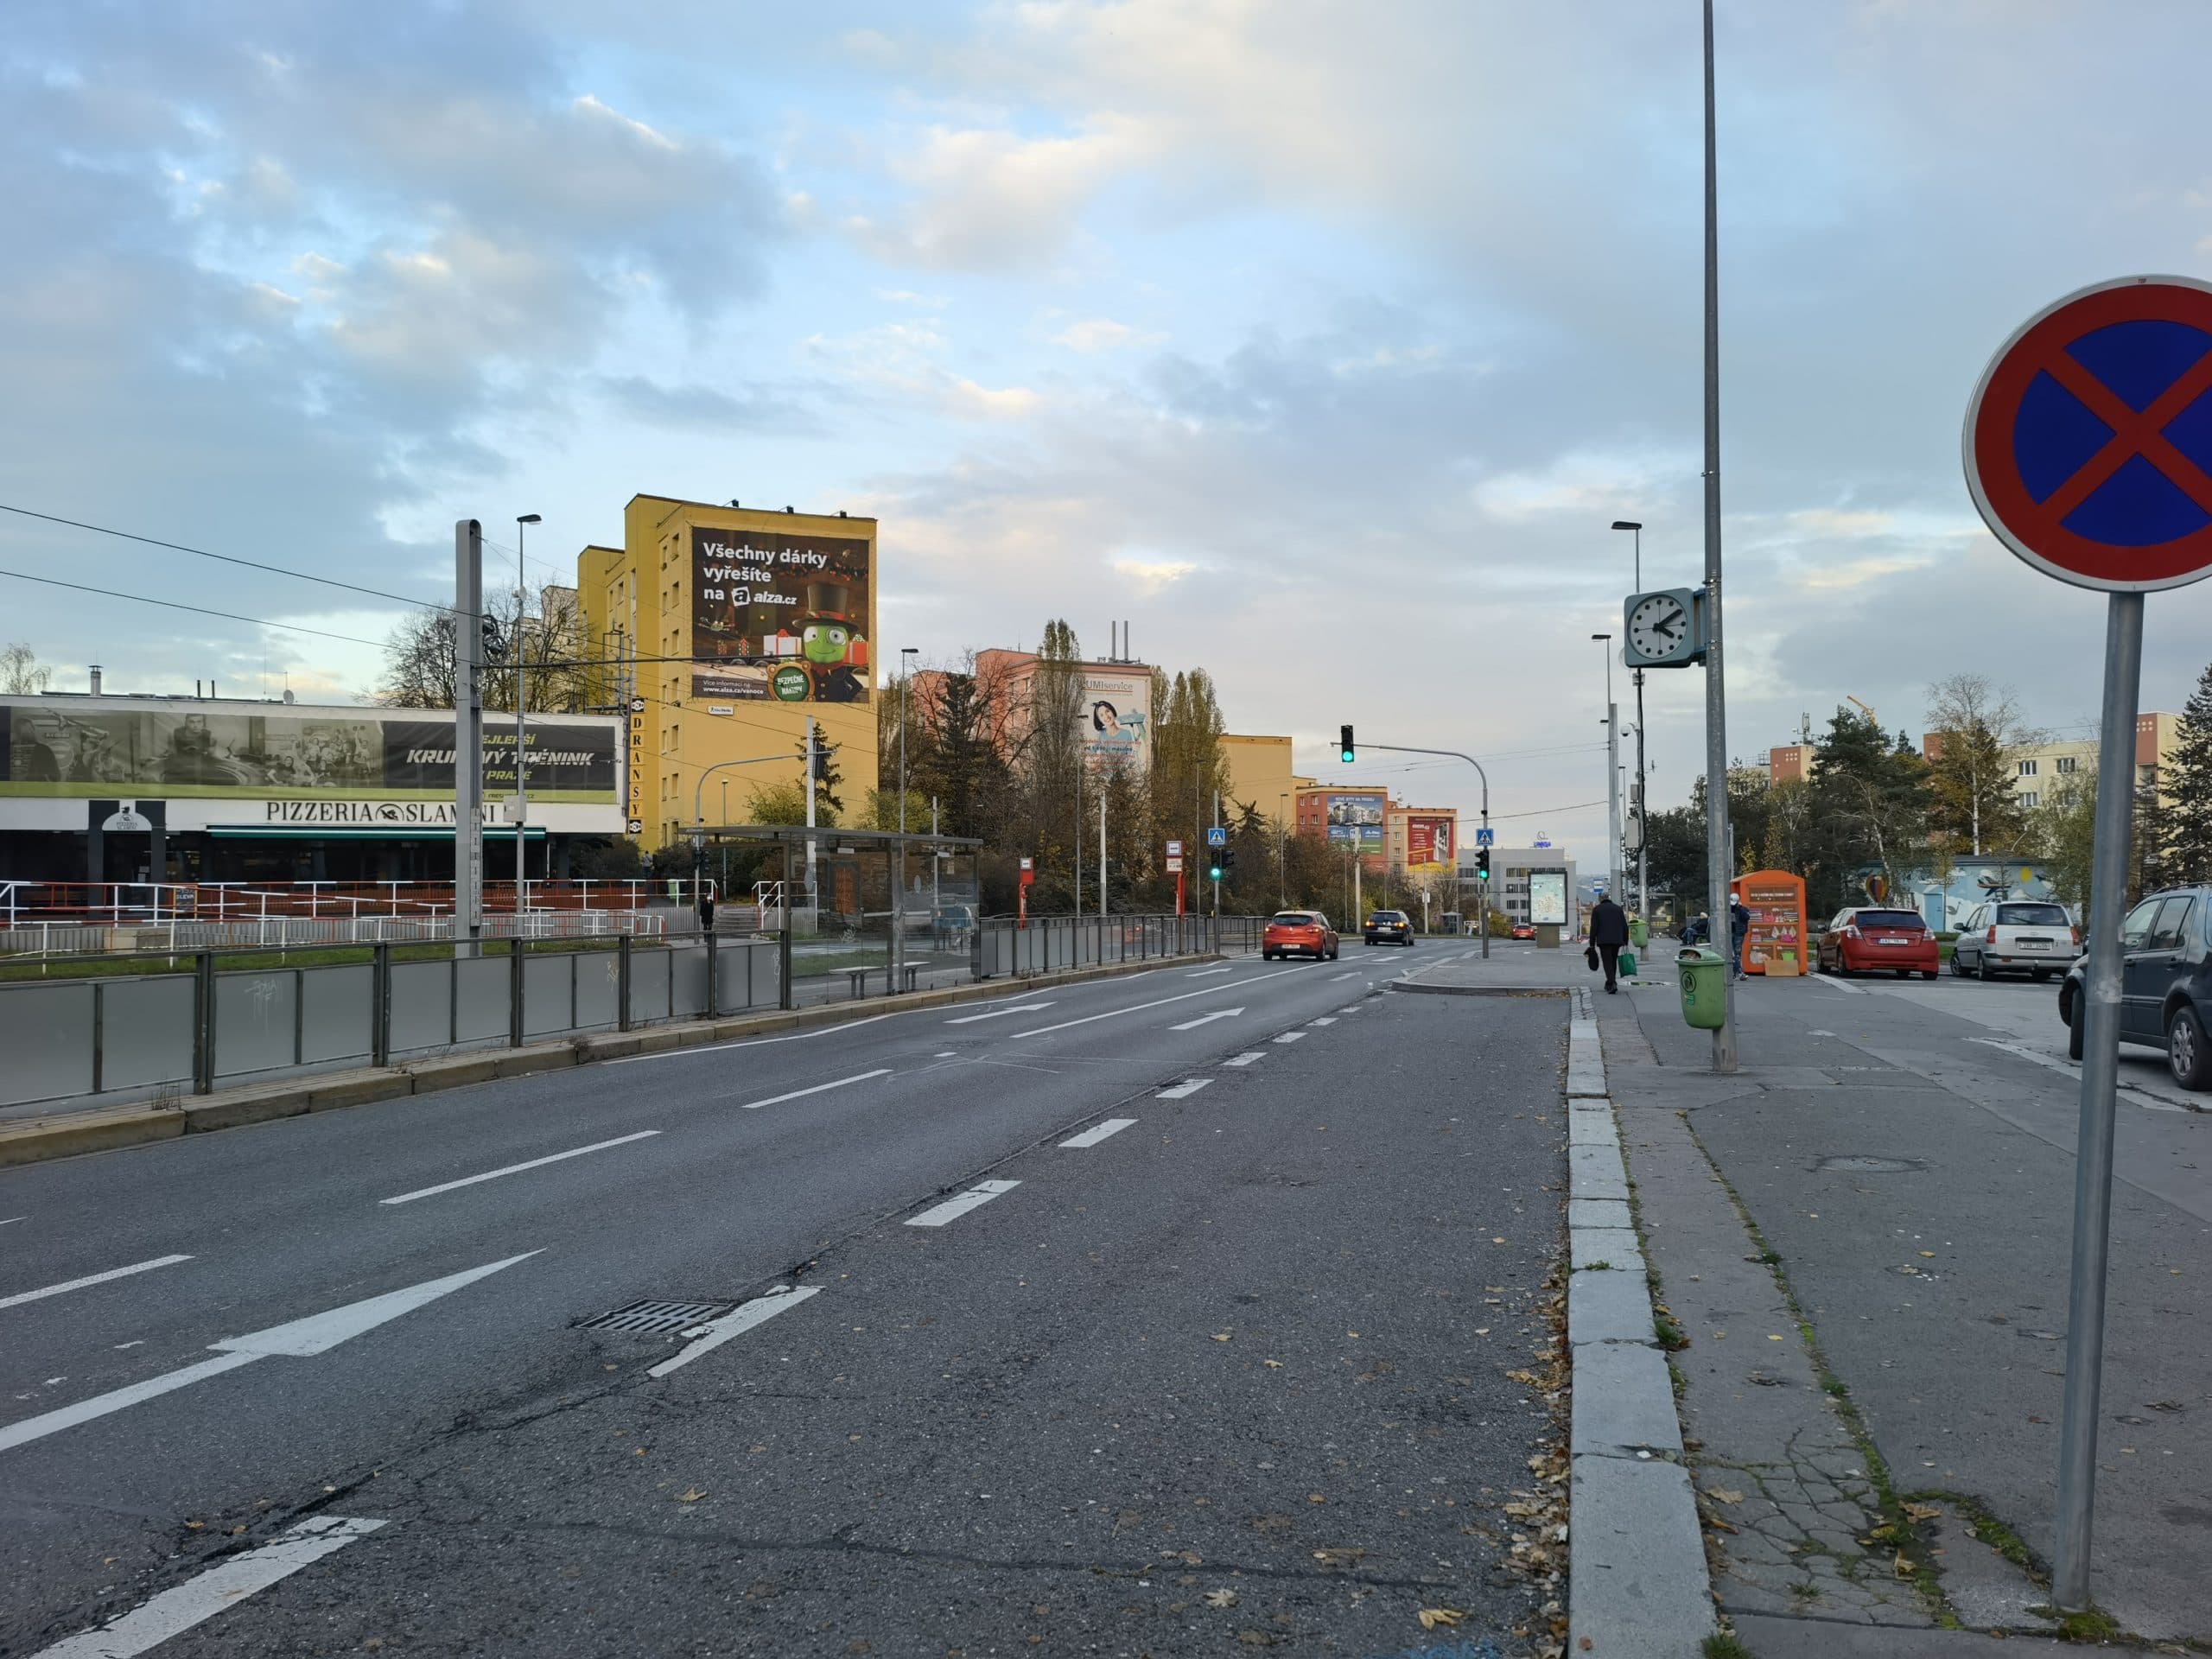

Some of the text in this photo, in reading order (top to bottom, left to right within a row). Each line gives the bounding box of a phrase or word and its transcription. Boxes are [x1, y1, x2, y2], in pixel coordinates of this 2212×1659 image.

[703, 543, 827, 569] Všechny dárky
[703, 566, 772, 582] vyřešíte
[704, 588, 724, 601] na
[753, 591, 797, 605] alza.cz
[1084, 679, 1134, 691] UMIservice
[632, 717, 642, 815] DRANSY
[267, 802, 373, 821] PIZZERIA
